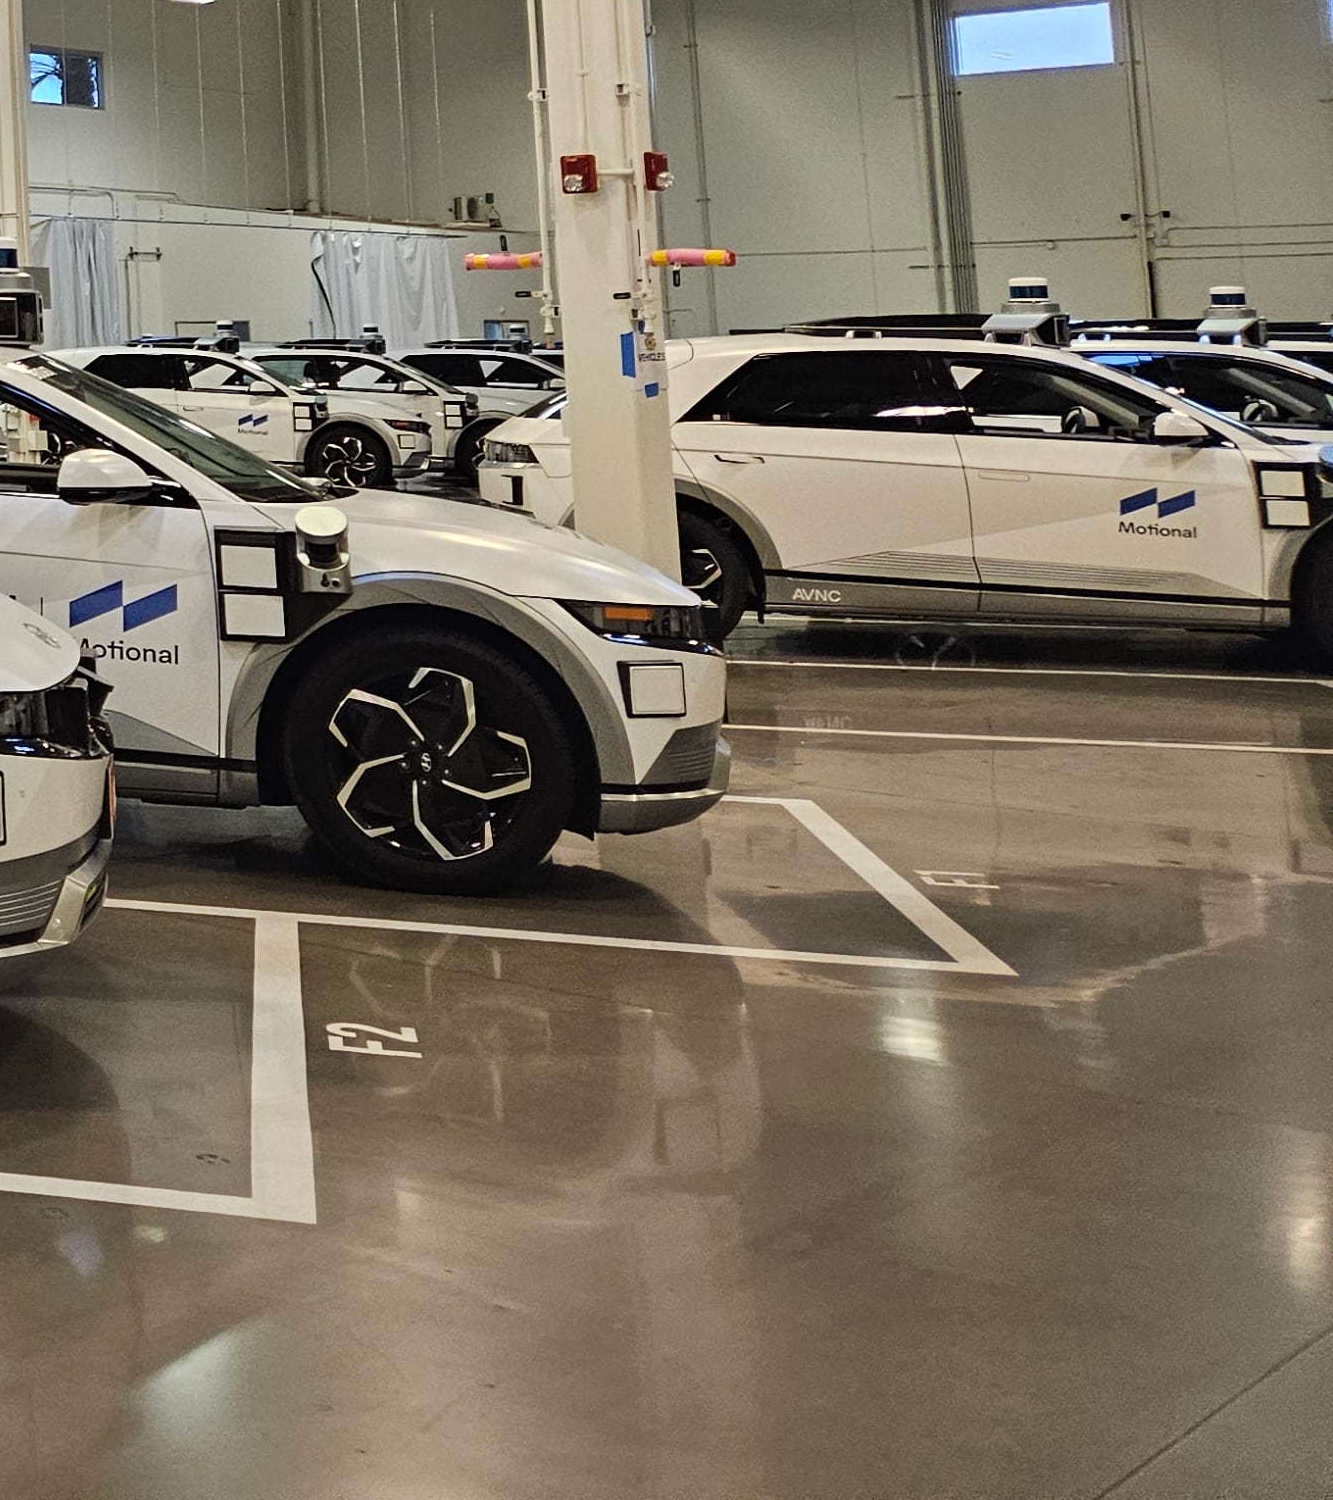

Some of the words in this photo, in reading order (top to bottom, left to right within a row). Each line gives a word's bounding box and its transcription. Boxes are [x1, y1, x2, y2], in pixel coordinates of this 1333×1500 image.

[1118, 521, 1198, 539] Motional
[792, 587, 842, 603] AVNC
[325, 1022, 424, 1059] F2
